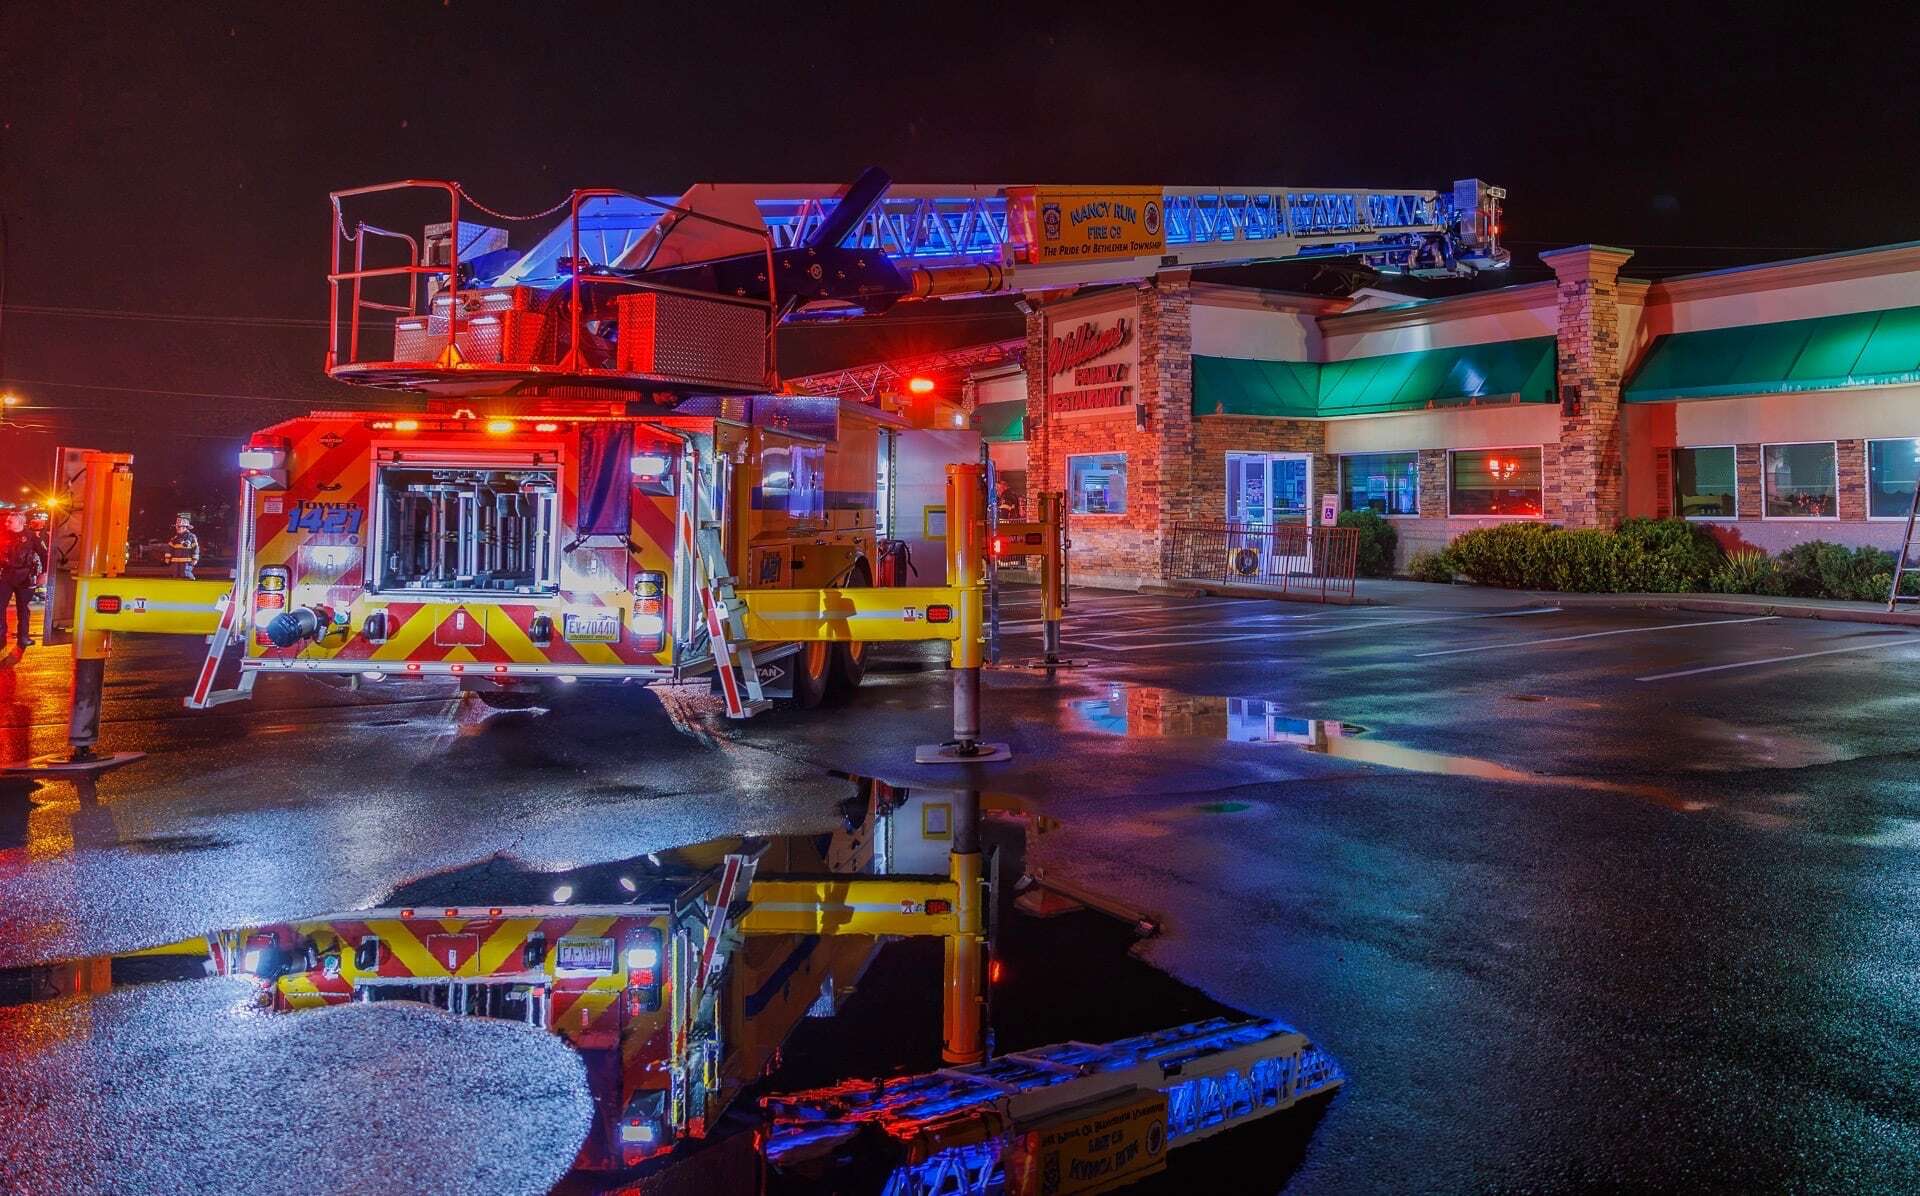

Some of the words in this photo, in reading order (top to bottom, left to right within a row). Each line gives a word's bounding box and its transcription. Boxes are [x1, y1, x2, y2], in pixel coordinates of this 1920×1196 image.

[1070, 202, 1112, 227] NANCY
[1114, 202, 1137, 225] RUN
[1087, 225, 1108, 240] FIRE
[1044, 246, 1057, 256] THE
[1059, 245, 1080, 256] PRIDE
[1093, 243, 1128, 253] BETHLEHEM
[1130, 240, 1162, 250] TOWNSHIP
[1075, 363, 1124, 386] FAMILY
[296, 499, 357, 511] TOWER
[287, 506, 363, 533] 1421
